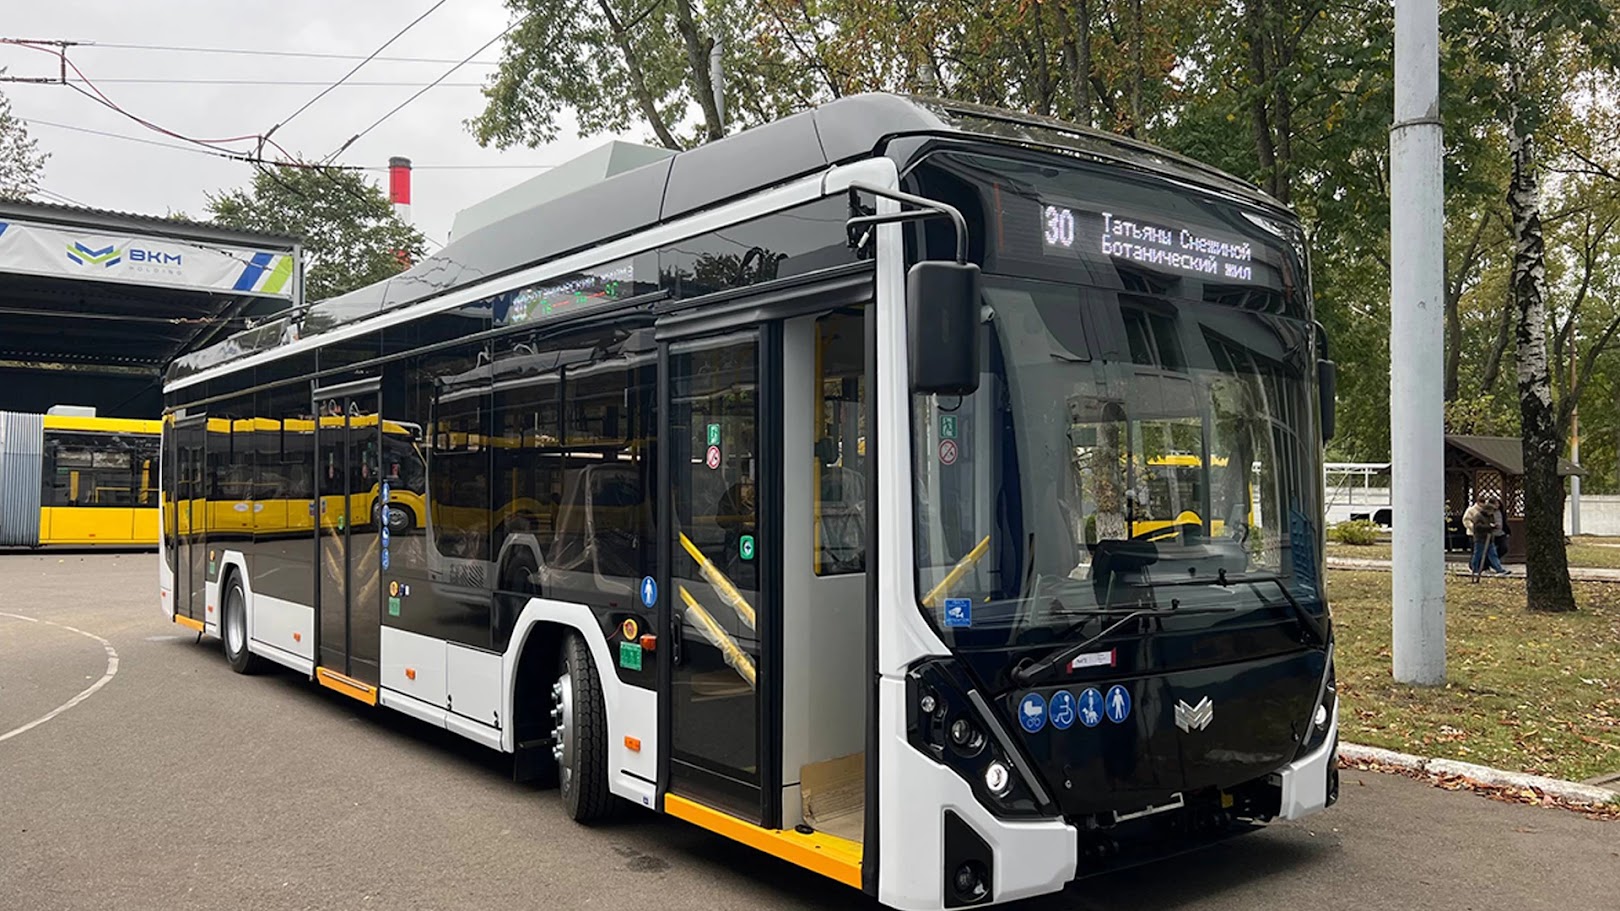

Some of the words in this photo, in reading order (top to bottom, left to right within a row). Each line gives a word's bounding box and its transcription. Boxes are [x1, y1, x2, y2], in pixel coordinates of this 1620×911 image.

[1044, 206, 1075, 248] 30
[1101, 212, 1172, 246] Татьяны
[129, 248, 182, 266] BKM
[1101, 234, 1217, 275] Ботанический
